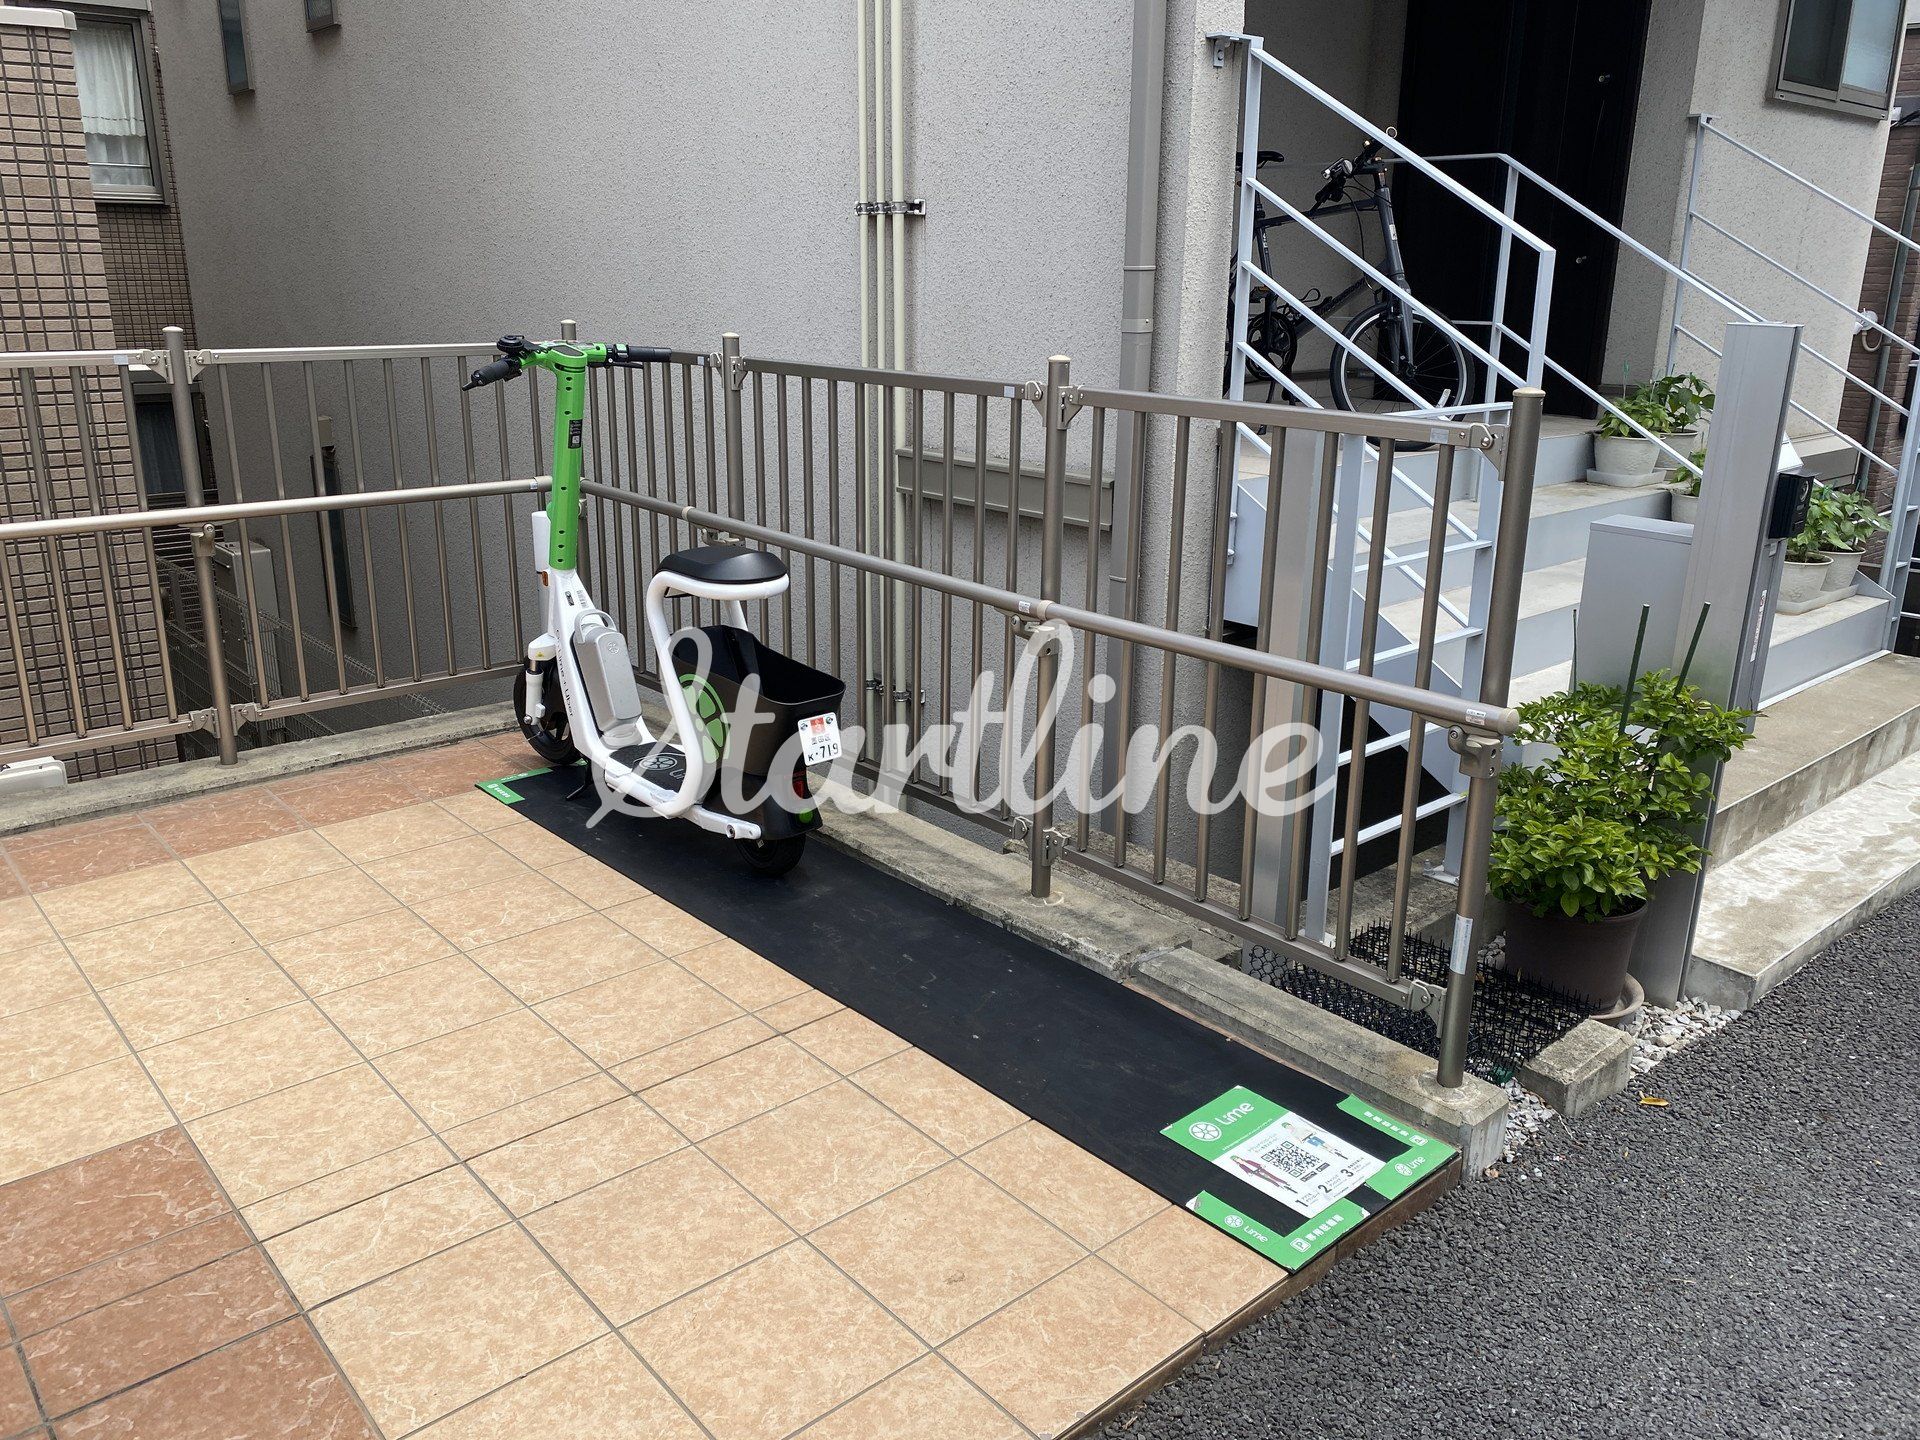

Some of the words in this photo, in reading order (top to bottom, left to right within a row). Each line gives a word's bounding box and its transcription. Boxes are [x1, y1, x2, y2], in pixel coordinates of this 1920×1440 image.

[1215, 1102, 1255, 1125] Lime
[1407, 1156, 1426, 1169] Lime
[1340, 1169, 1354, 1177] 3
[1318, 1185, 1332, 1193] 2
[1295, 1199, 1309, 1207] 1
[1243, 1225, 1269, 1243] Lime
